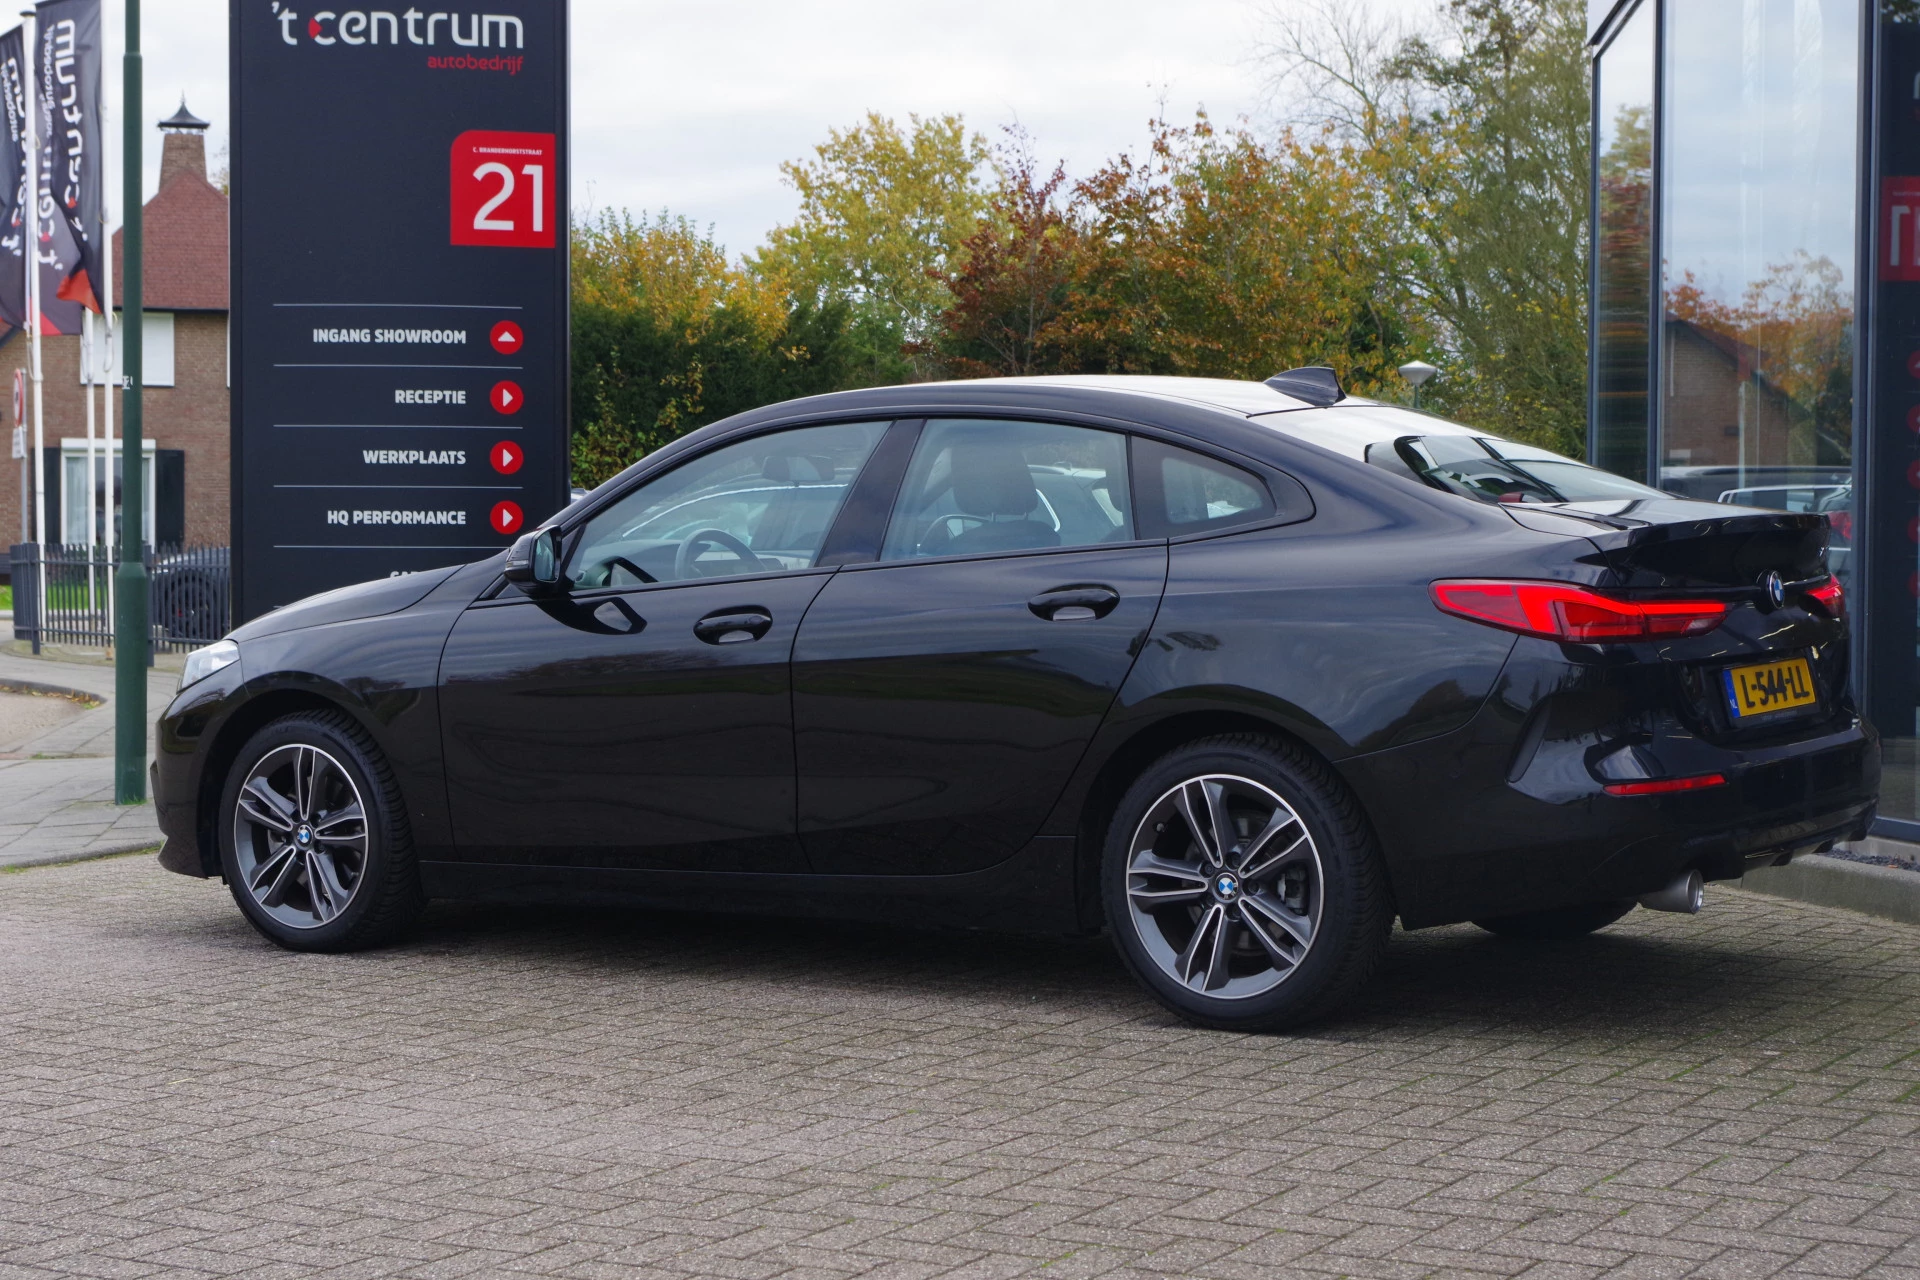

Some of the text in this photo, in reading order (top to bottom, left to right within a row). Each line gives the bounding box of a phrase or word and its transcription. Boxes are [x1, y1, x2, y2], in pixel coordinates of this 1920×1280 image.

[308, 6, 524, 49] centrum
[427, 54, 524, 76] autobedrijf
[472, 161, 544, 232] 21
[312, 328, 467, 345] INGANG SHOWROOM
[394, 389, 467, 405] RECEPTIE
[363, 450, 467, 465] WERKPLAATS
[326, 510, 467, 526] HQ PERFORMANCE
